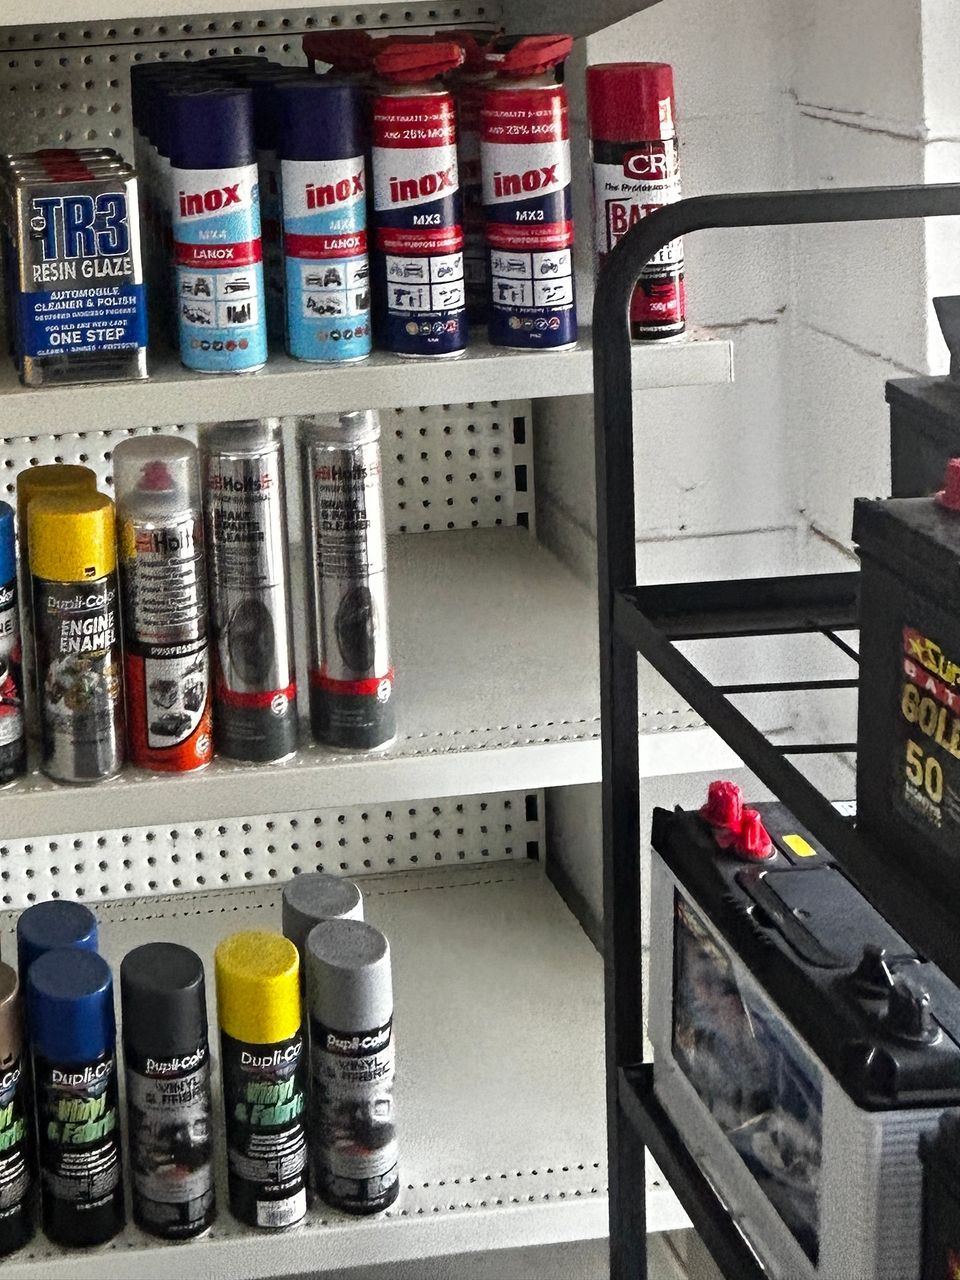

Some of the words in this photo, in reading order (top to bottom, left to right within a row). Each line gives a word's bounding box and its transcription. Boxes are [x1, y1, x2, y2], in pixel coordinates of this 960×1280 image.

[628, 154, 672, 174] CR
[305, 171, 365, 210] inox
[390, 168, 455, 203] inox
[493, 163, 560, 198] inox
[179, 183, 242, 217] inox
[32, 192, 131, 261] TR3
[413, 212, 442, 225] MX3
[33, 261, 77, 282] RESIN
[82, 257, 133, 279] GLAZE
[49, 331, 82, 346] ONE
[86, 328, 125, 343] STEP
[61, 611, 114, 636] ENGINE
[59, 629, 116, 653] ENAMEL
[905, 738, 944, 804] 50
[241, 1037, 303, 1068] Dupli-Co
[52, 1059, 113, 1087] Dupli-Co
